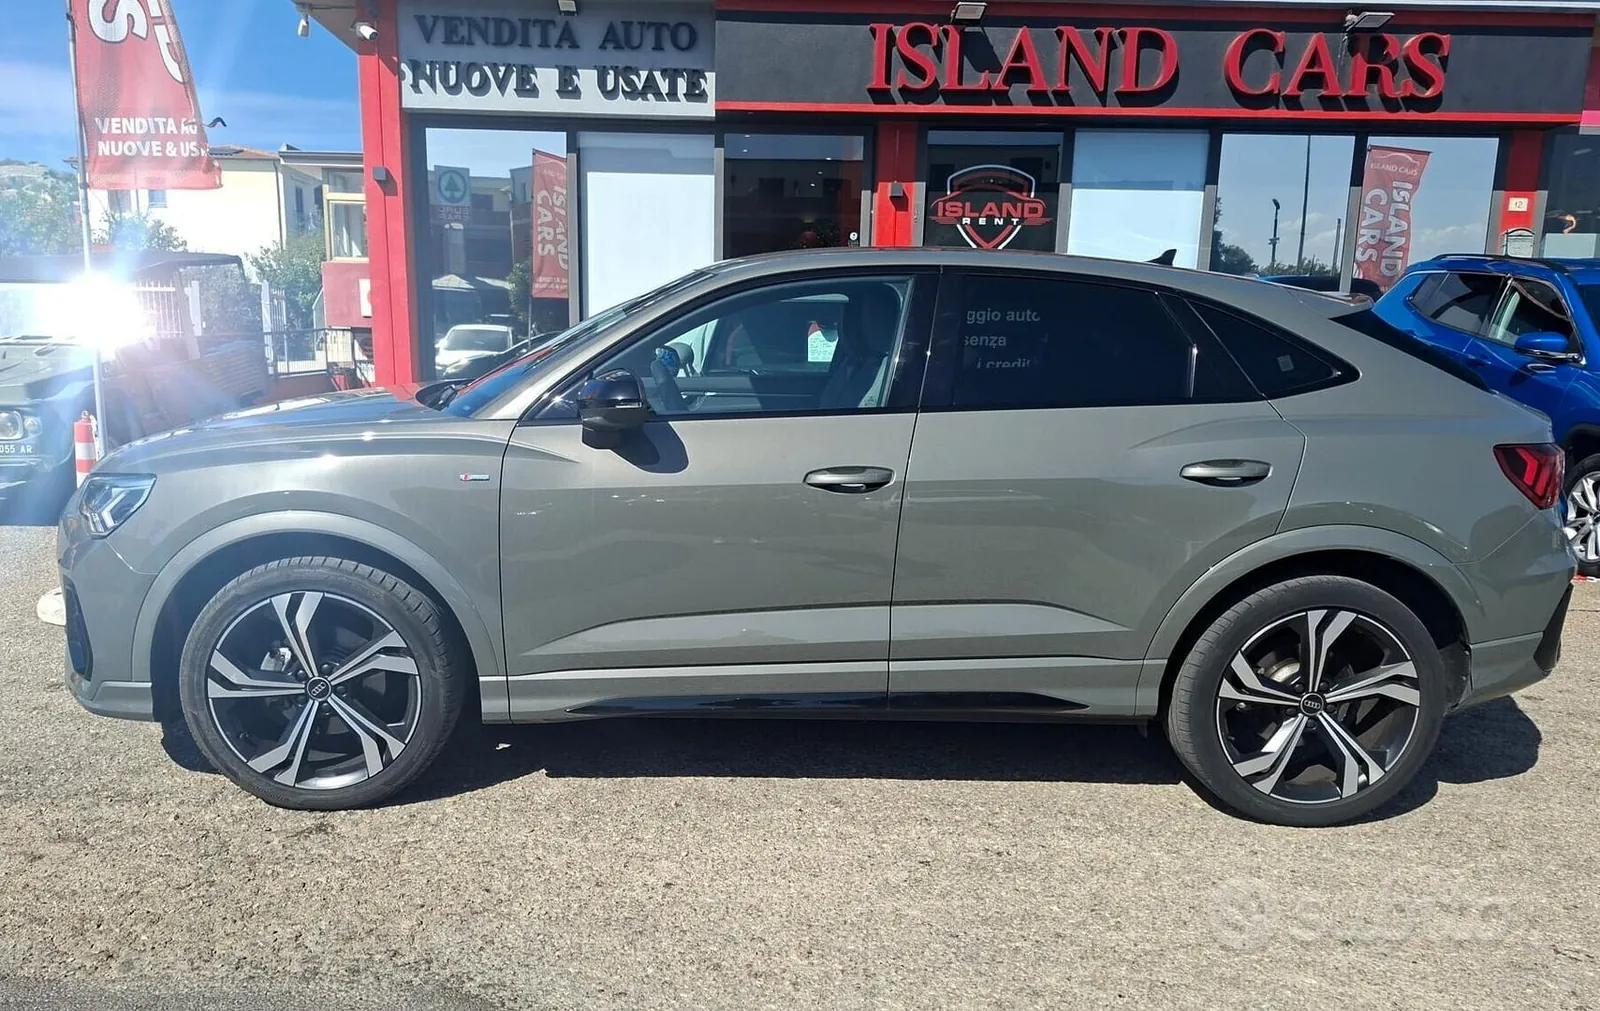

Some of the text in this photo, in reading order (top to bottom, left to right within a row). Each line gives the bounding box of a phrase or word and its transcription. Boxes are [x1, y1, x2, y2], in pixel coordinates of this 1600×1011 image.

[413, 14, 697, 51] VENDITA AUTO
[866, 22, 1452, 99] ISLAND CARS
[408, 58, 708, 101] NUOVE E USATE
[95, 117, 177, 135] VENDITA
[97, 140, 162, 157] NUOVE
[165, 141, 177, 157] &
[937, 201, 1044, 217] ISLAND
[1514, 201, 1523, 209] 12
[537, 190, 555, 256] CARS
[962, 218, 1020, 226] RENT
[1355, 188, 1388, 262] CARS
[1380, 180, 1413, 277] ISLAND
[20, 444, 33, 454] AR
